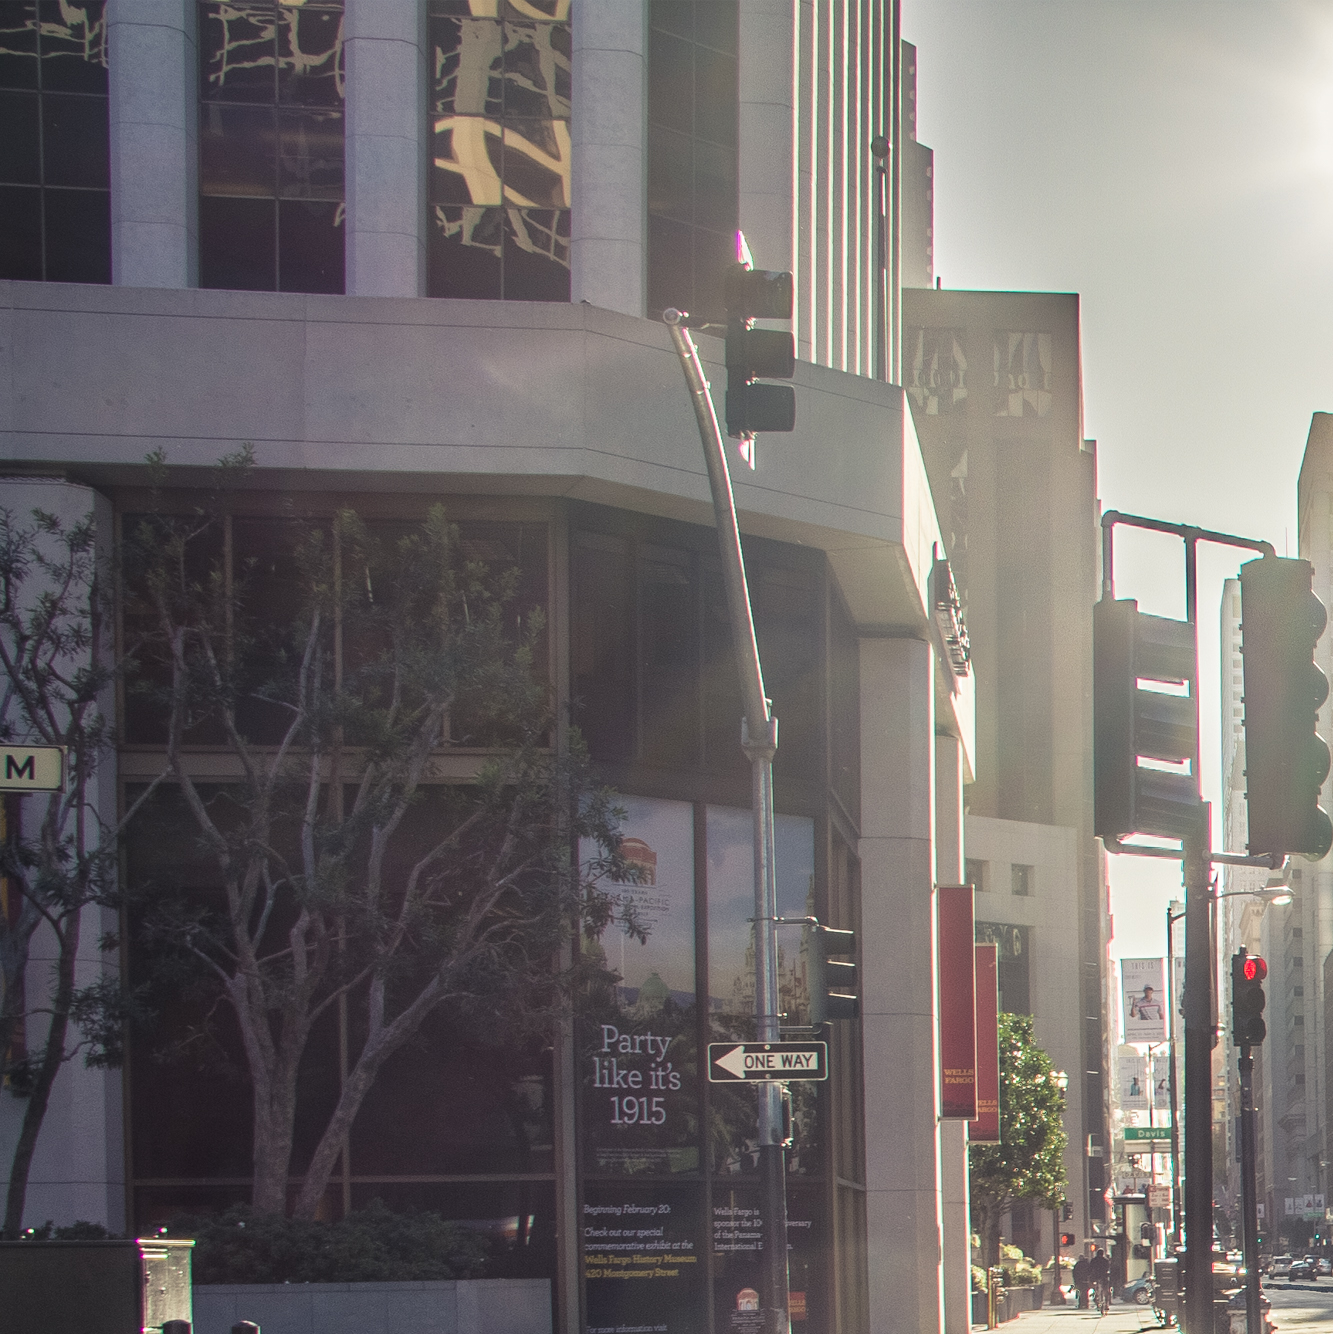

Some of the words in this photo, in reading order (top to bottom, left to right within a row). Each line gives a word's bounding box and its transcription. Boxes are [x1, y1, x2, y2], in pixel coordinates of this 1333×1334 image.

[600, 1024, 673, 1062] Party
[743, 1054, 776, 1069] ONE
[780, 1053, 815, 1068] WAY
[593, 1056, 643, 1089] like
[649, 1062, 681, 1090] it's
[943, 1068, 974, 1076] WELLS
[610, 1096, 667, 1125] 1915
[1137, 1129, 1166, 1138] Davis
[583, 1204, 622, 1215] Beginning
[623, 1203, 658, 1215] February
[713, 1207, 733, 1216] Wells
[733, 1207, 753, 1218] Fargo
[753, 1207, 761, 1216] is
[741, 1218, 753, 1228] the
[785, 1220, 812, 1230] versary
[584, 1226, 608, 1238] Check
[608, 1228, 622, 1237] out
[623, 1229, 636, 1237] our
[636, 1226, 664, 1239] special
[713, 1231, 722, 1240] of
[722, 1231, 733, 1240] the
[584, 1242, 645, 1251] commemorative
[645, 1240, 671, 1250] exhibit
[671, 1241, 680, 1250] at
[680, 1240, 694, 1250] the
[714, 1242, 757, 1251] International
[585, 1254, 607, 1264] Wells
[608, 1254, 632, 1266] Fargo
[632, 1254, 663, 1265] History
[663, 1254, 697, 1263] Museum
[603, 1268, 654, 1279] Montgomery
[654, 1267, 679, 1277] Street
